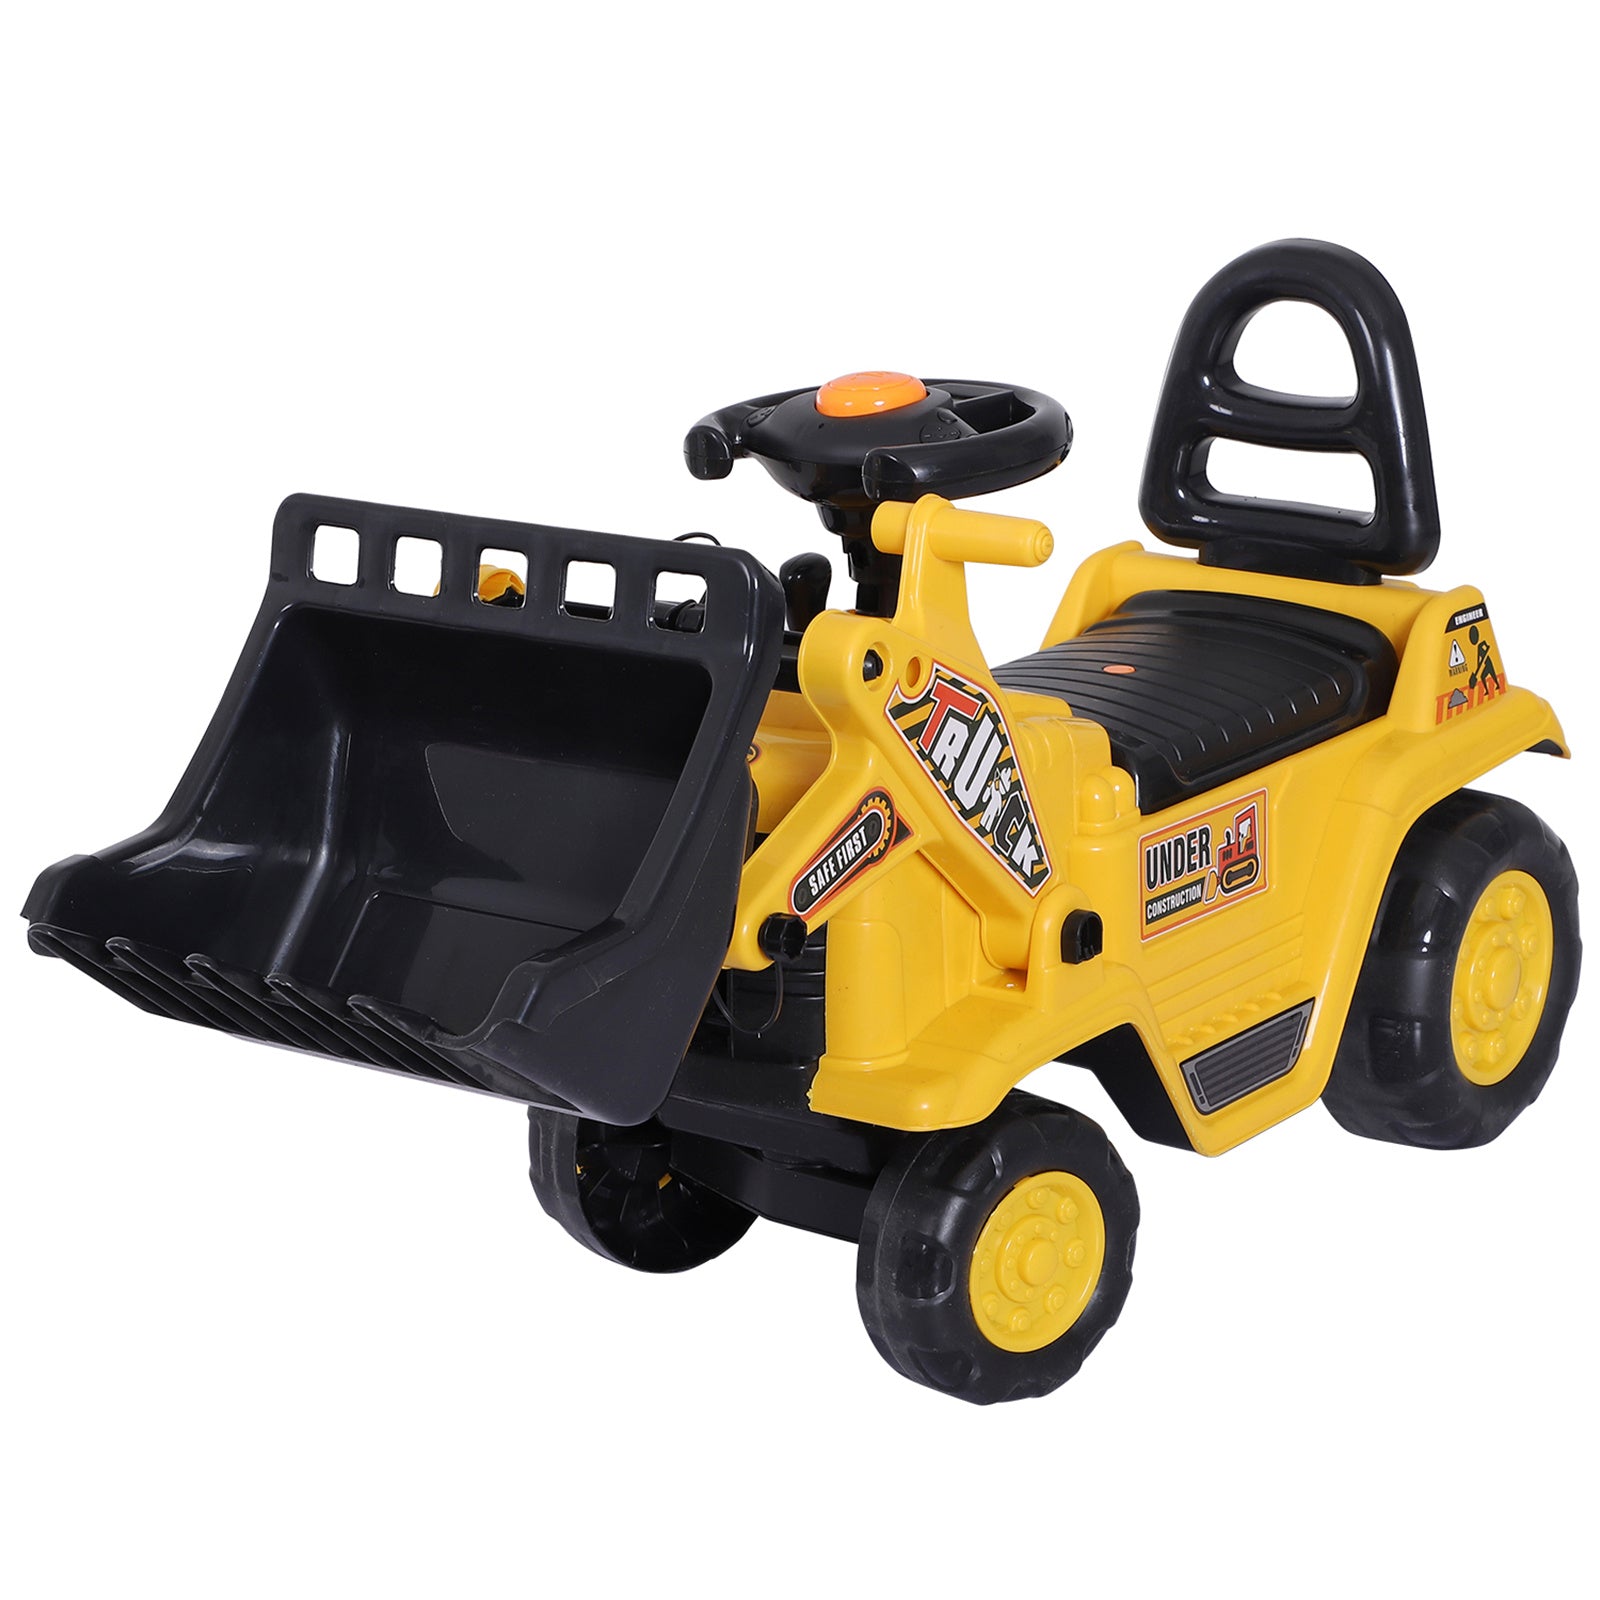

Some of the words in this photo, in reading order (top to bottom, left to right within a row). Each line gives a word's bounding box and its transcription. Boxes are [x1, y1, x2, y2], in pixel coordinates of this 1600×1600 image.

[1455, 608, 1484, 626] ENGINEER
[1449, 663, 1468, 677] WARNING
[918, 678, 1040, 878] TRUCK
[808, 857, 837, 896] SAFE
[835, 826, 868, 870] FIRST
[1146, 825, 1212, 891] UNDER
[1146, 883, 1202, 920] CONSTRUCTION
